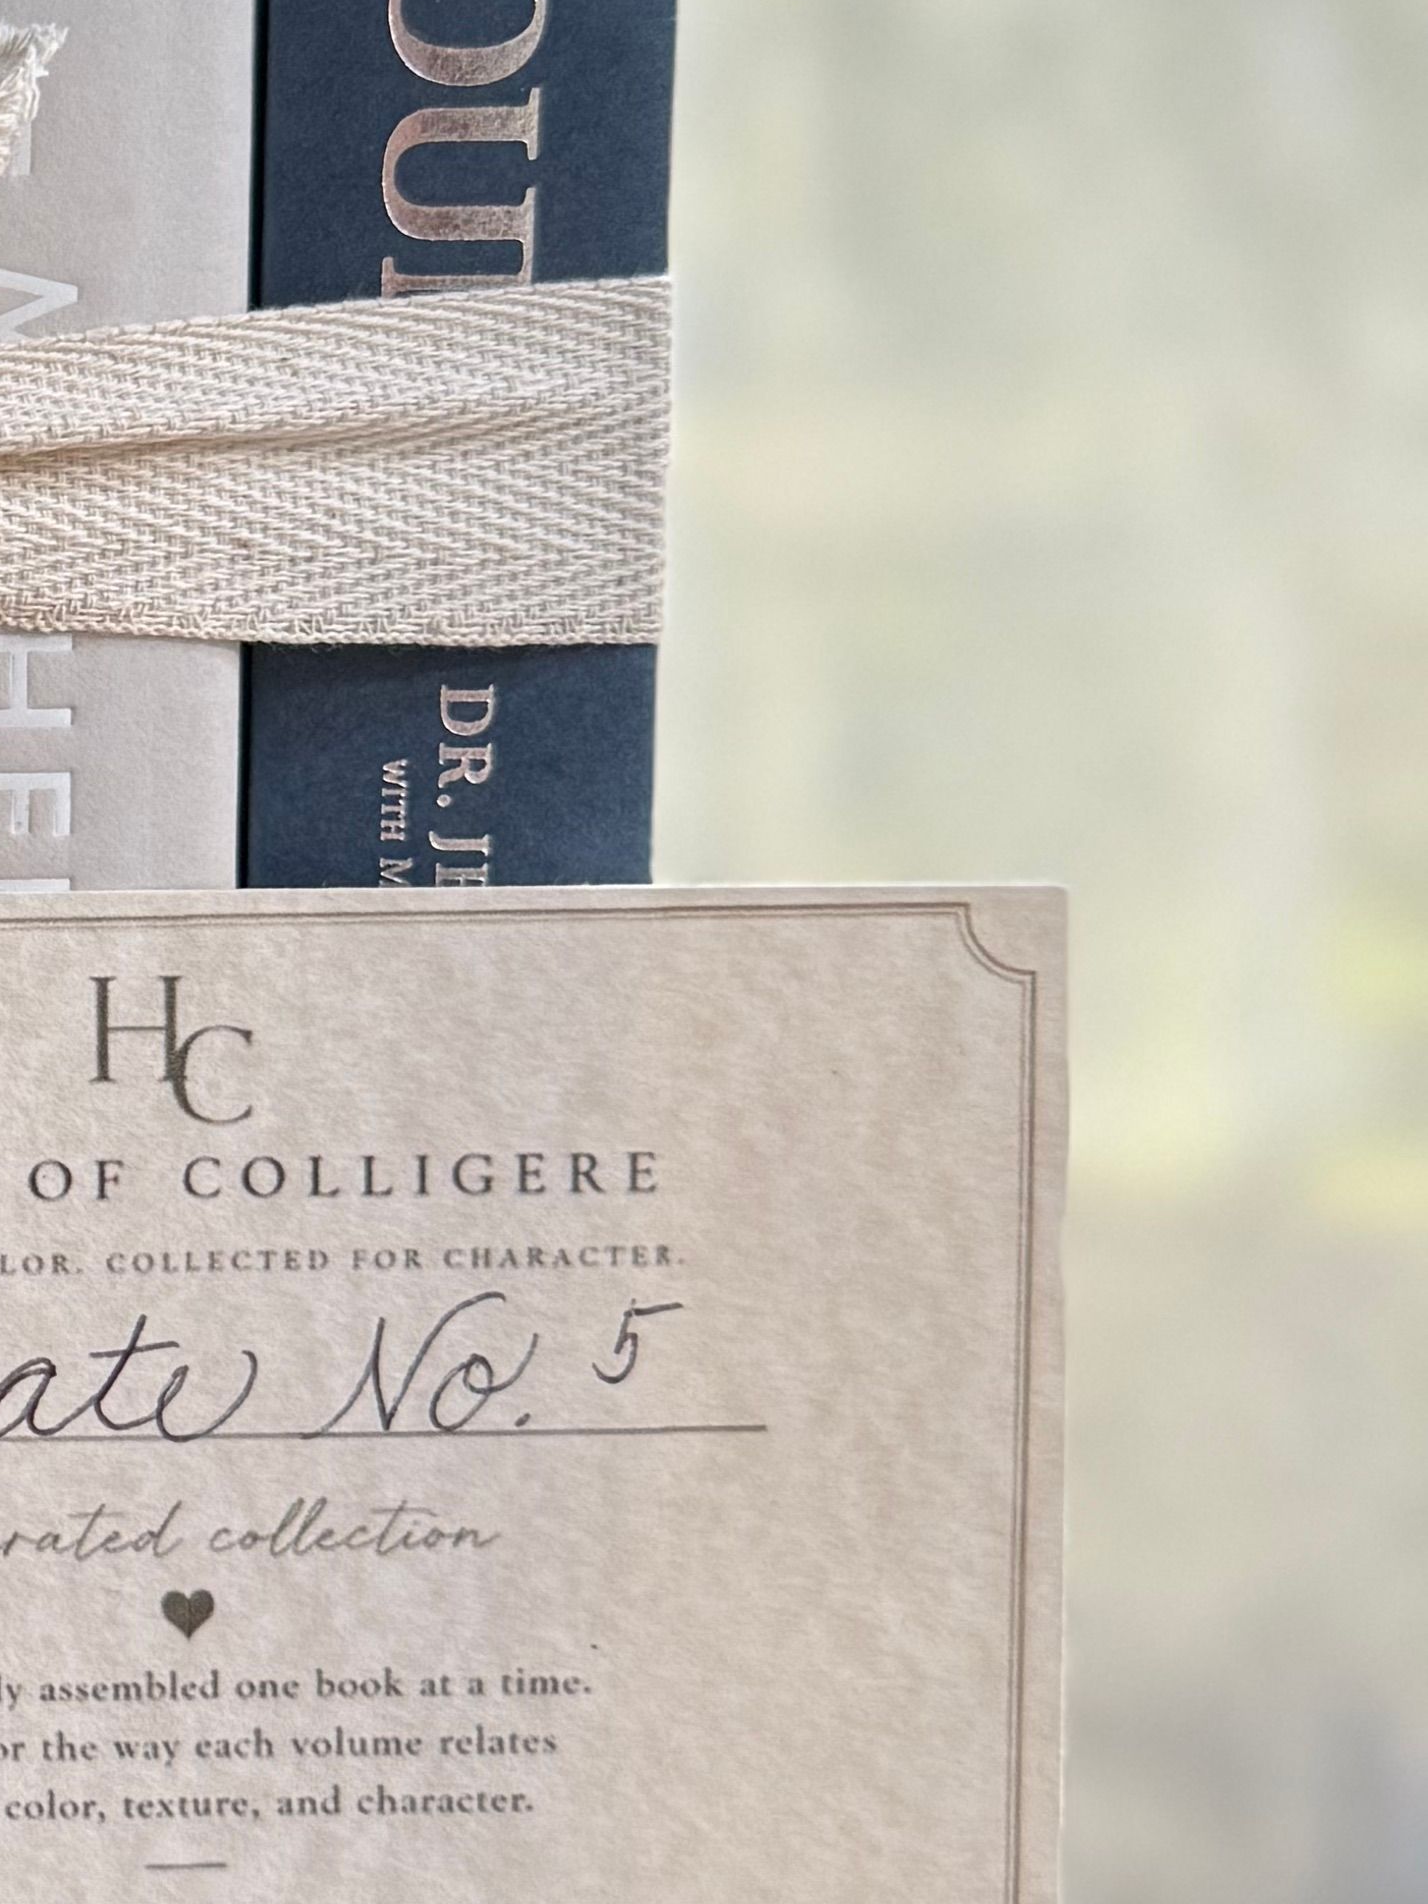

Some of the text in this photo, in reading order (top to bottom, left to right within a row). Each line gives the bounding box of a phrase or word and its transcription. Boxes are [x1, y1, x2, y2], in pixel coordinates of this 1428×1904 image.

[435, 682, 496, 809] DR.
[379, 758, 409, 842] WITH
[26, 1157, 126, 1204] OF
[180, 1149, 659, 1201] COLLIGERE
[103, 1247, 332, 1277] COLLECTED
[350, 1246, 424, 1273] FOR
[440, 1242, 686, 1271] CHARACTER.
[299, 1291, 543, 1439] No.
[590, 1296, 686, 1387] 5
[207, 1494, 503, 1561] collection
[37, 1667, 222, 1705] assembled
[233, 1677, 302, 1702] one
[313, 1664, 405, 1700] book
[417, 1673, 454, 1699] at
[465, 1675, 487, 1698] a
[499, 1665, 594, 1698] time.
[40, 1728, 100, 1764] the
[111, 1738, 182, 1769] way
[192, 1725, 277, 1761] each
[289, 1724, 425, 1759] volume
[437, 1722, 560, 1758] relates
[2, 1786, 108, 1825] color,
[121, 1795, 263, 1823] texture,
[275, 1782, 344, 1818] and
[354, 1782, 536, 1818] character.
